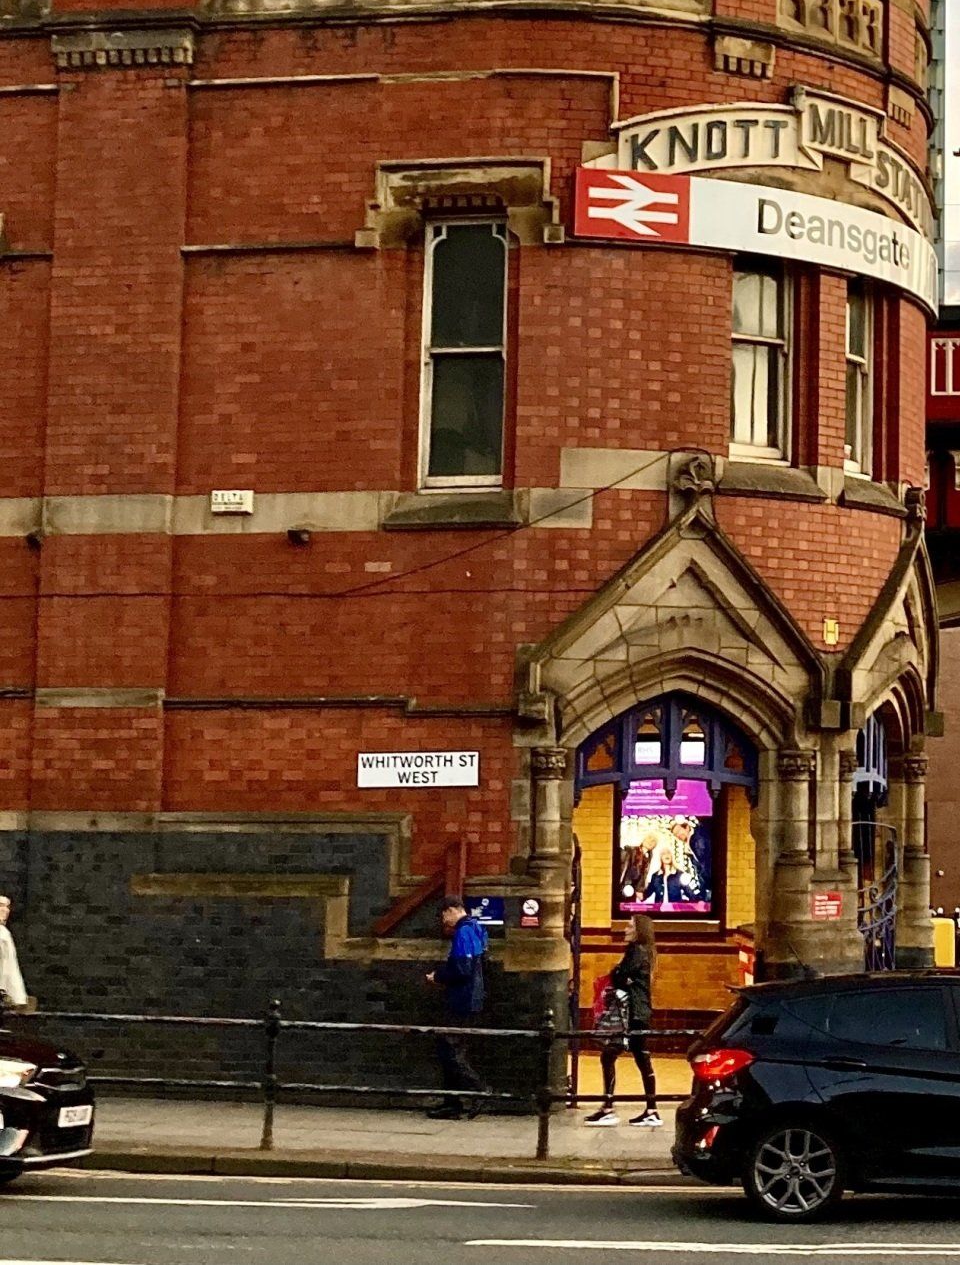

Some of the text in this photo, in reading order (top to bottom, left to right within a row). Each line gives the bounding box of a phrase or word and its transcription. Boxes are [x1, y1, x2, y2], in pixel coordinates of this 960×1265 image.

[630, 119, 789, 171] KNOTT
[808, 103, 874, 159] MILL
[757, 197, 911, 270] Deansgate
[360, 754, 477, 769] WHITWORTH ST
[397, 770, 439, 784] WEST
